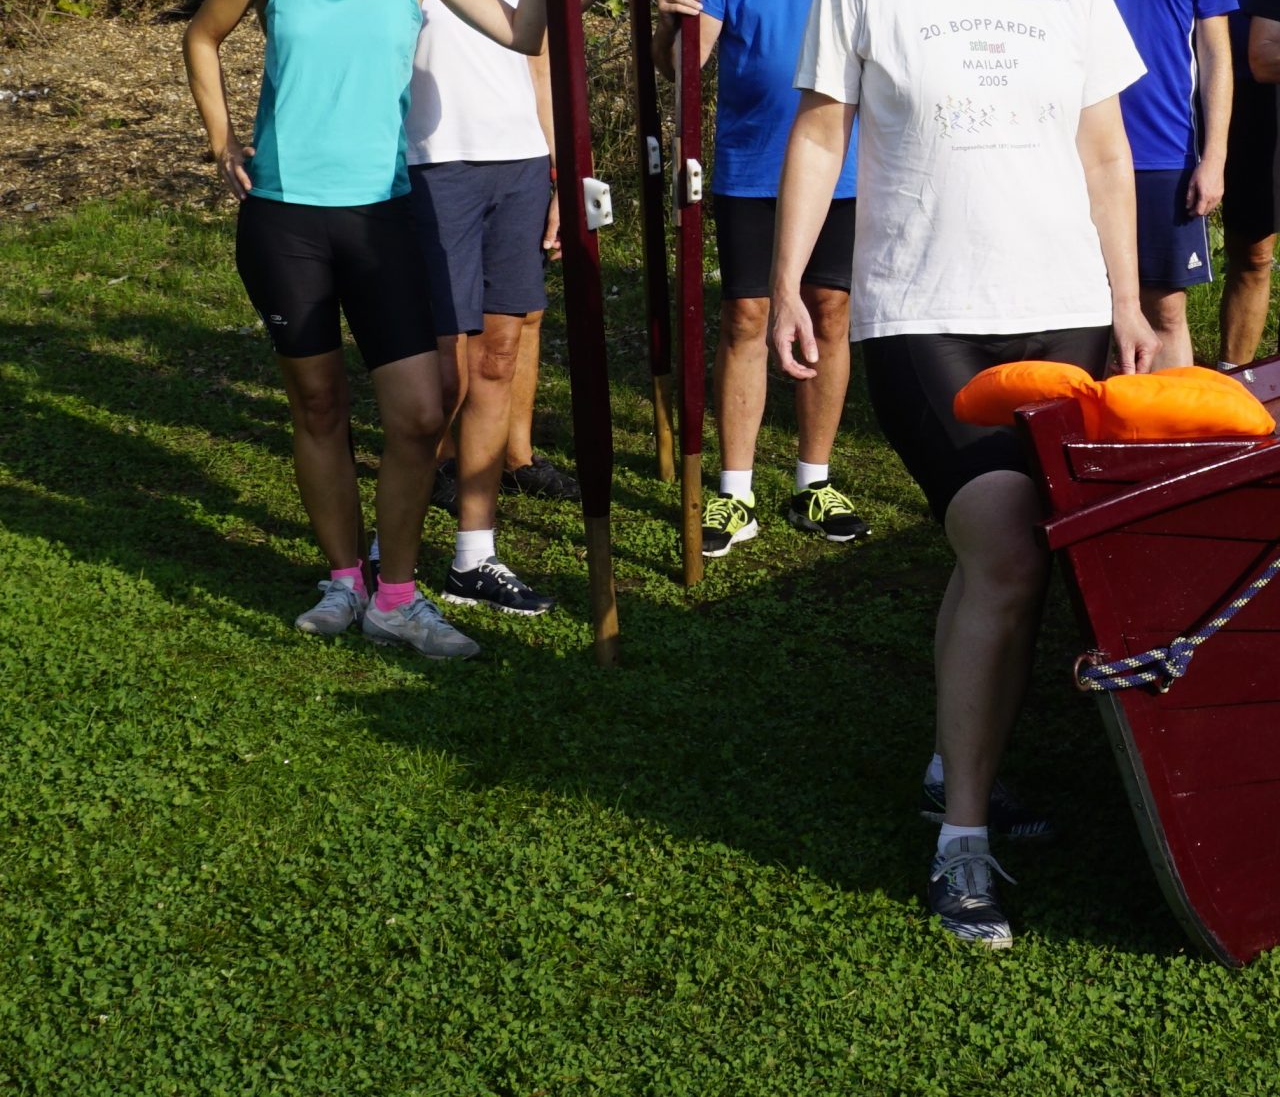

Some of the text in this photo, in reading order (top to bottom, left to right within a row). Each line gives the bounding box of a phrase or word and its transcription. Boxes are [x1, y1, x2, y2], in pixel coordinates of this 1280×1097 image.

[919, 18, 1047, 41] 20. BOPPARDER
[962, 58, 1020, 70] MAILAUF
[978, 75, 1009, 87] 2005
